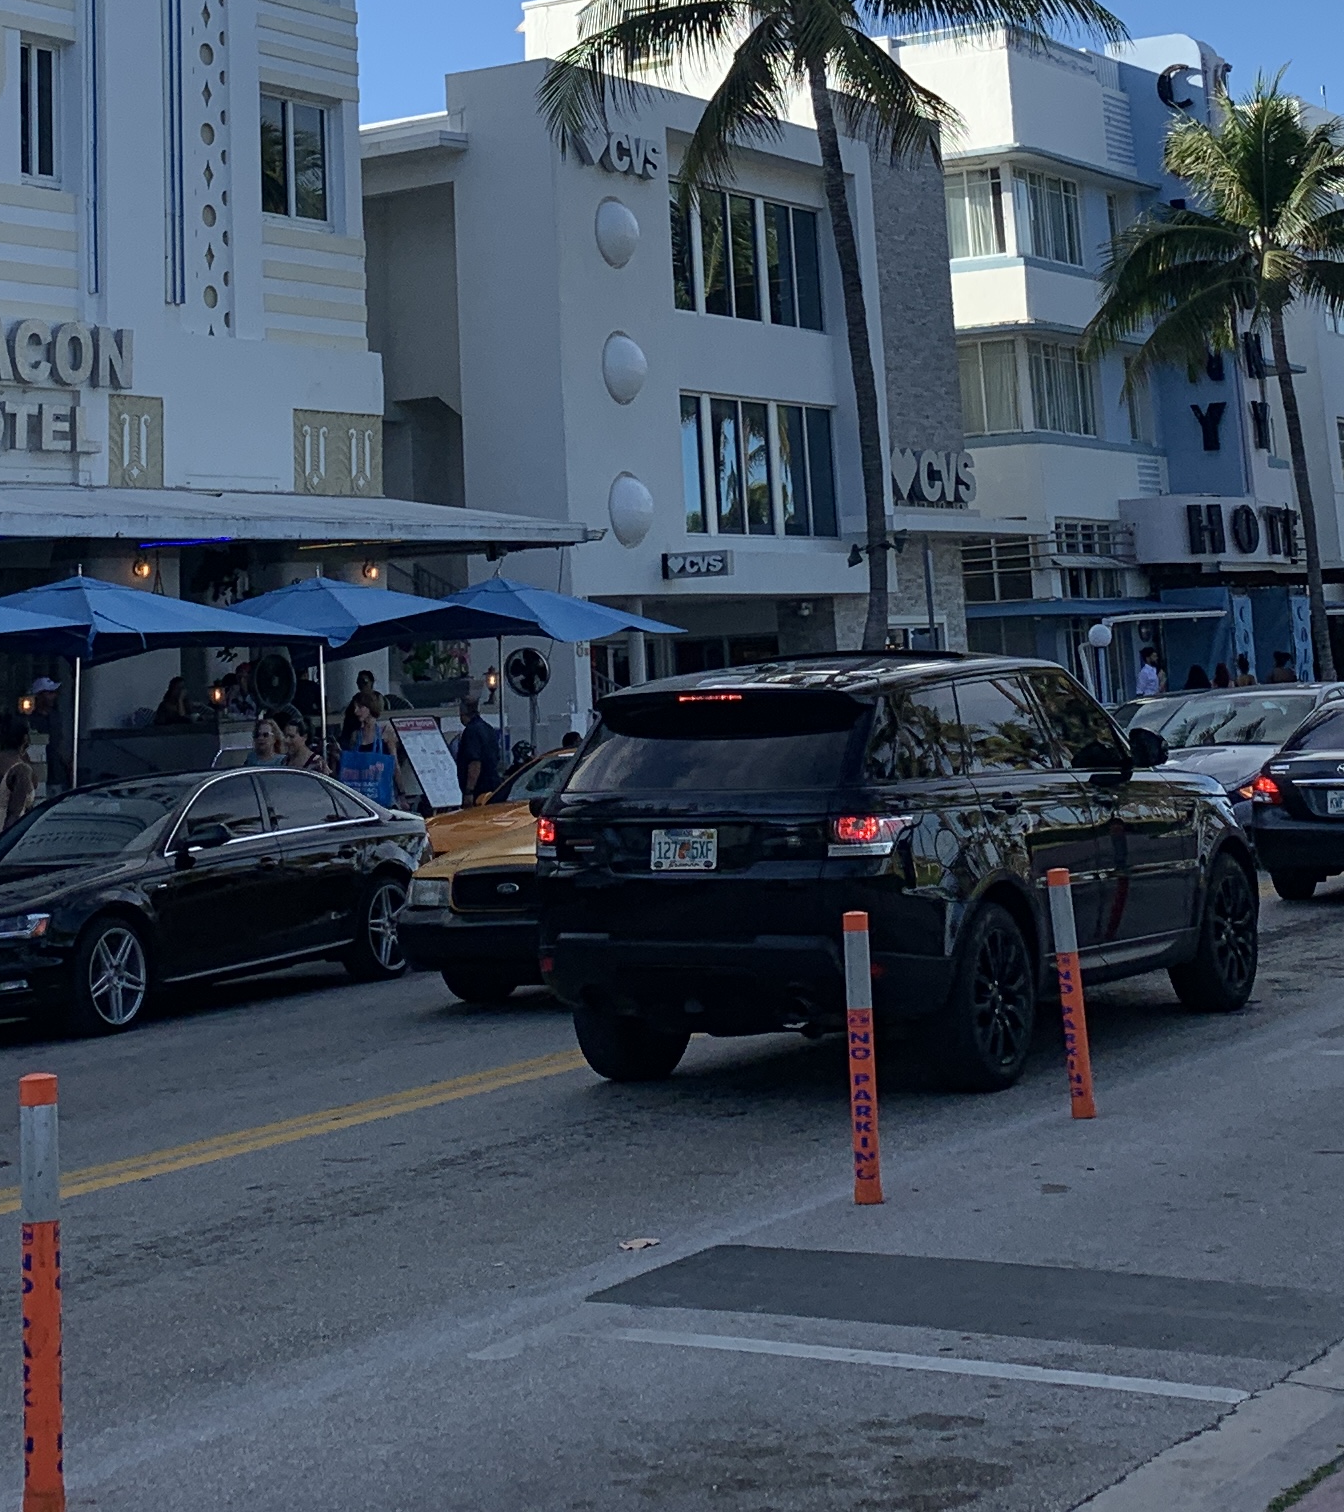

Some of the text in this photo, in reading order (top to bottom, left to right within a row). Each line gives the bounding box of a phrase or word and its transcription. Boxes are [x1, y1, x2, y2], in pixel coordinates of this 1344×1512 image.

[610, 132, 663, 179] CVS
[919, 448, 978, 503] CVS
[685, 555, 724, 574] CVS
[850, 1031, 871, 1061] NO
[853, 1072, 877, 1181] PARKING
